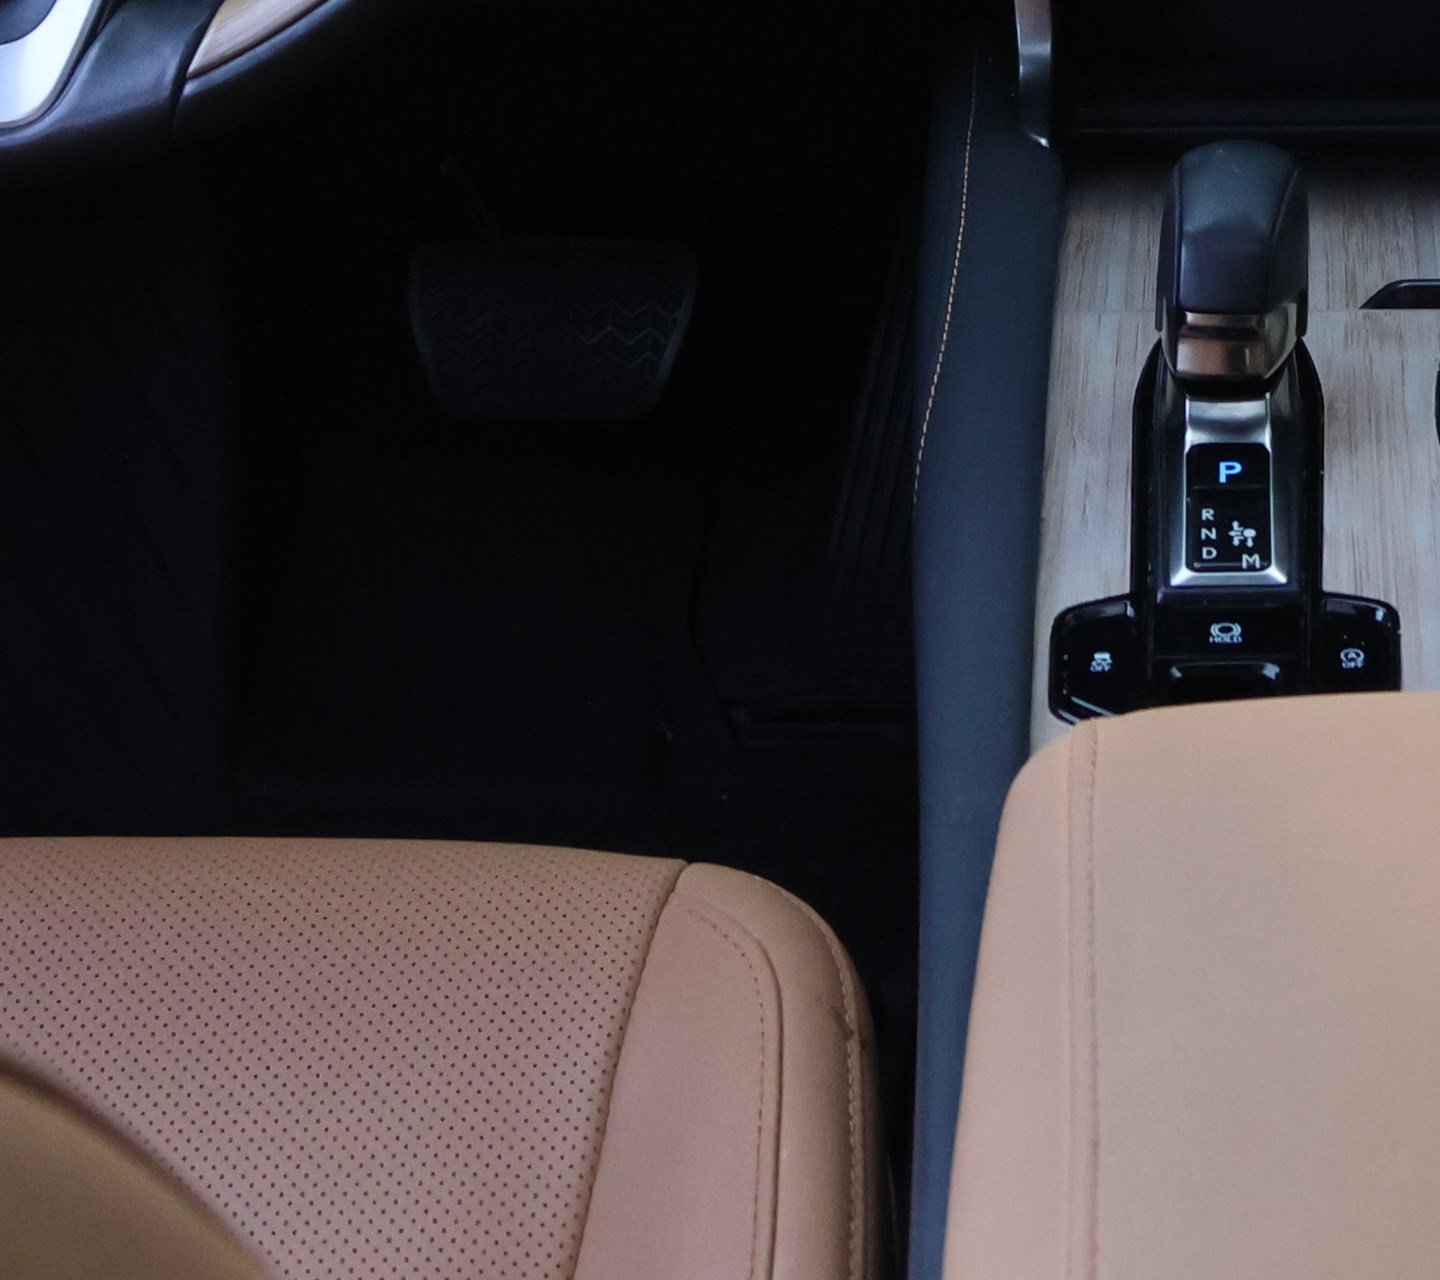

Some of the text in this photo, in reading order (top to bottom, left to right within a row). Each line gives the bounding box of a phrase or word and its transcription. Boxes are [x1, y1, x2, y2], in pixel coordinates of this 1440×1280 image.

[1218, 460, 1243, 485] P
[1201, 507, 1215, 521] R
[1200, 527, 1217, 541] N
[1201, 546, 1218, 560] D
[1241, 553, 1261, 570] M
